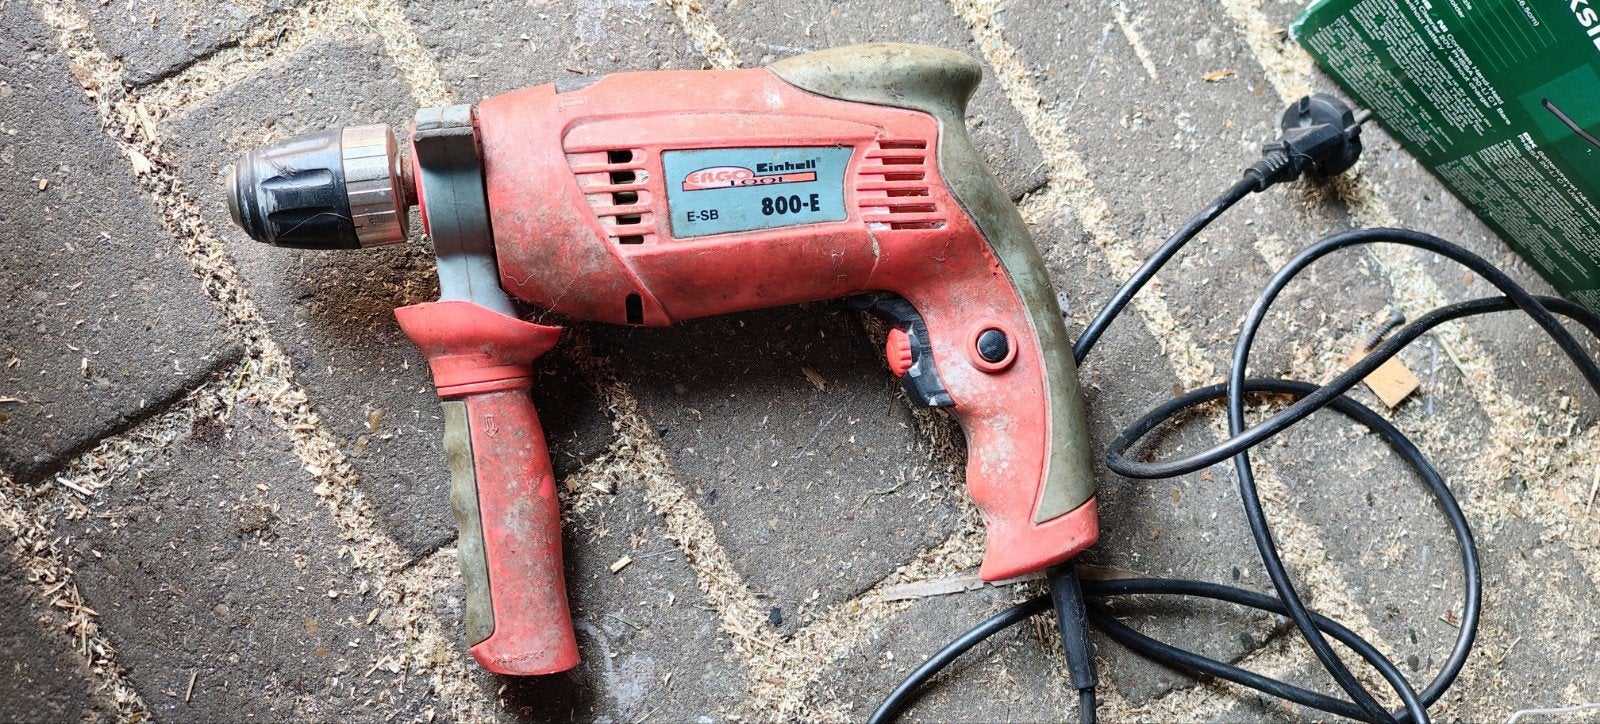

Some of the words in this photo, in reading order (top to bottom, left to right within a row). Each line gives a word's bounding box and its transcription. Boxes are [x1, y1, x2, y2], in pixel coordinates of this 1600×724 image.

[1417, 4, 1442, 34] Cleaner
[1438, 33, 1453, 50] 20V
[1487, 94, 1497, 106] C1
[1496, 106, 1512, 125] Bare
[1422, 24, 1445, 51] battery
[1447, 54, 1470, 82] without
[1467, 81, 1491, 110] charger
[1446, 32, 1473, 66] Cordless
[1471, 65, 1504, 105] Hand-Held
[1522, 130, 1537, 149] DK
[687, 209, 719, 222] E-SB
[761, 193, 820, 216] 800-E
